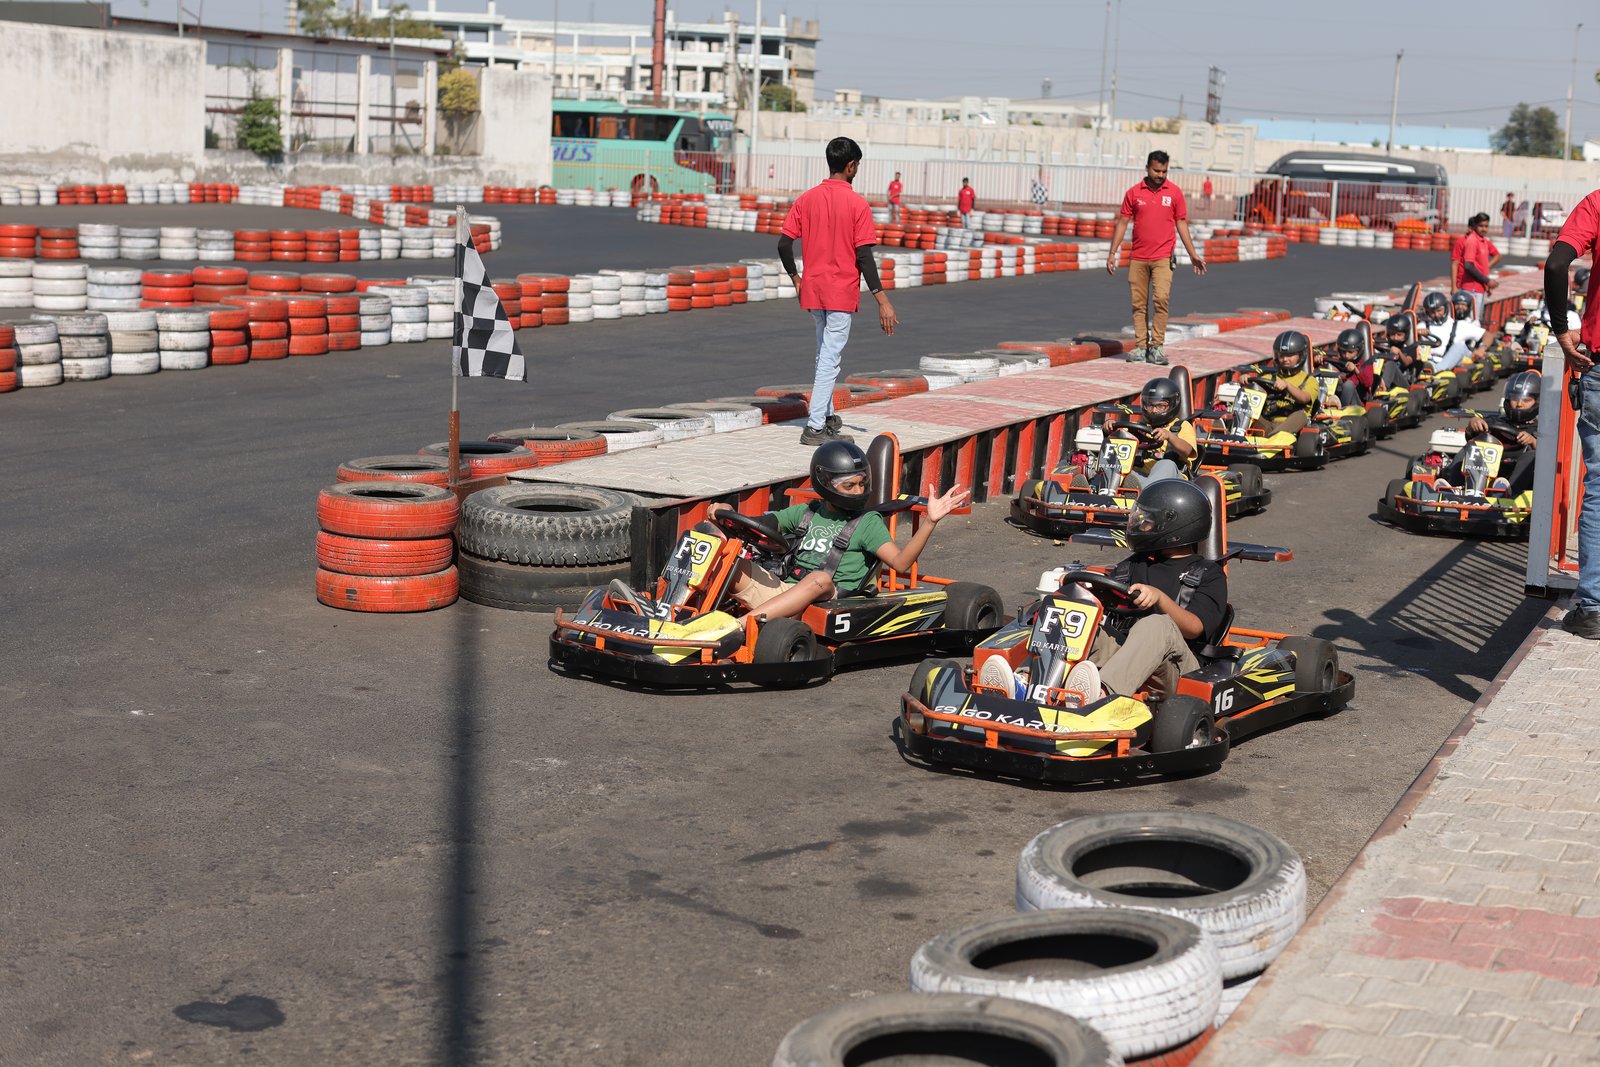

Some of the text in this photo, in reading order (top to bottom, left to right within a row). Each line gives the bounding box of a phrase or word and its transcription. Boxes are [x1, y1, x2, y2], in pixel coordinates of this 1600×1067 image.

[1238, 391, 1261, 408] F9
[1103, 443, 1131, 460] F9
[1469, 446, 1497, 464] F9
[674, 536, 713, 565] F9
[654, 602, 671, 618] 5
[835, 612, 851, 634] 5
[1039, 605, 1087, 638] F9
[1026, 684, 1047, 704] 16
[1214, 687, 1234, 714] 16
[962, 708, 992, 719] GO
[995, 714, 1078, 733] KARTIN
